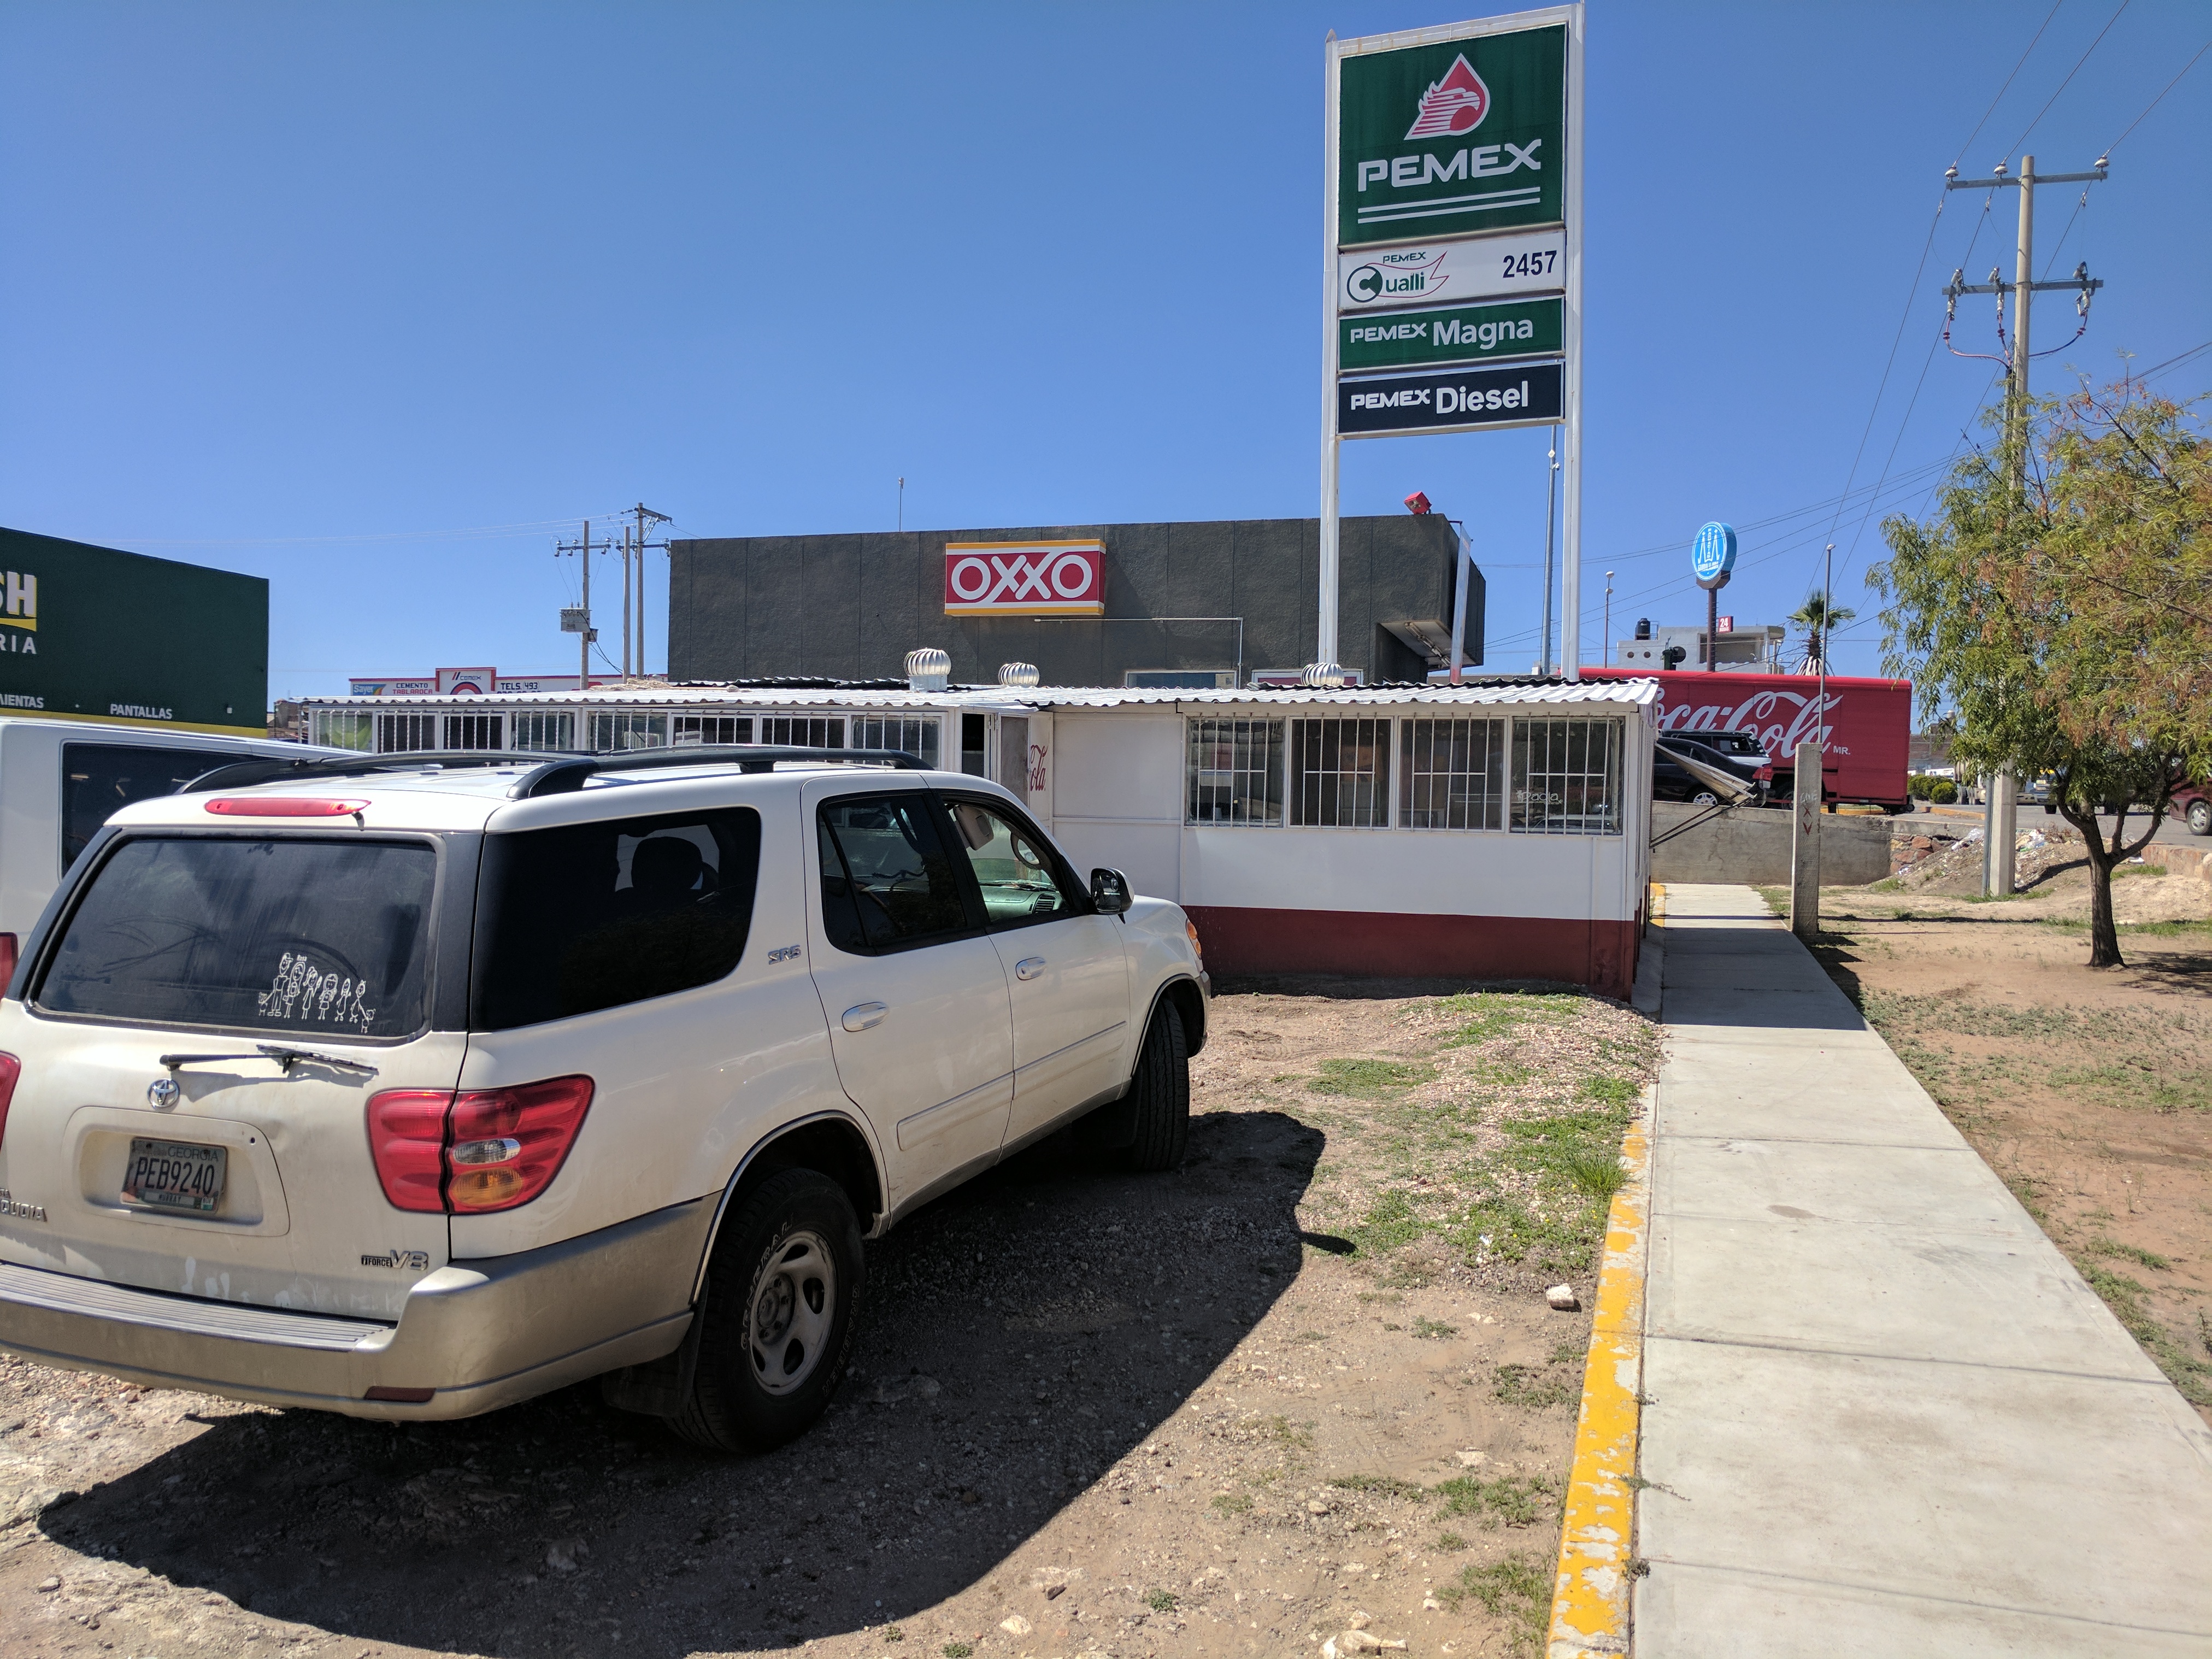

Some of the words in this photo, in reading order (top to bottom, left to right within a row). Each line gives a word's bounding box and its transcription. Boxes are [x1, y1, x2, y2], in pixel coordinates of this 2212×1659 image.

[1358, 139, 1542, 192] PEMEX
[1382, 252, 1426, 264] PEMEX
[1503, 250, 1557, 278] 2457
[1350, 323, 1427, 343] PEMEX
[1433, 320, 1533, 350] Magna
[1350, 389, 1431, 410] PEMEX
[1436, 381, 1528, 414] Diesel
[951, 552, 1092, 602] OXXO
[1720, 617, 1728, 628] 24
[354, 684, 374, 696] Sayer
[523, 681, 540, 691] (493)
[110, 703, 173, 720] PANTALLAS
[1657, 687, 1843, 758] oca-Cola
[1833, 745, 1851, 755] MR.
[768, 945, 802, 966] SR5
[168, 1146, 219, 1162] GEORGIA
[133, 1156, 215, 1196] PEB9240
[390, 1249, 429, 1270] V8
